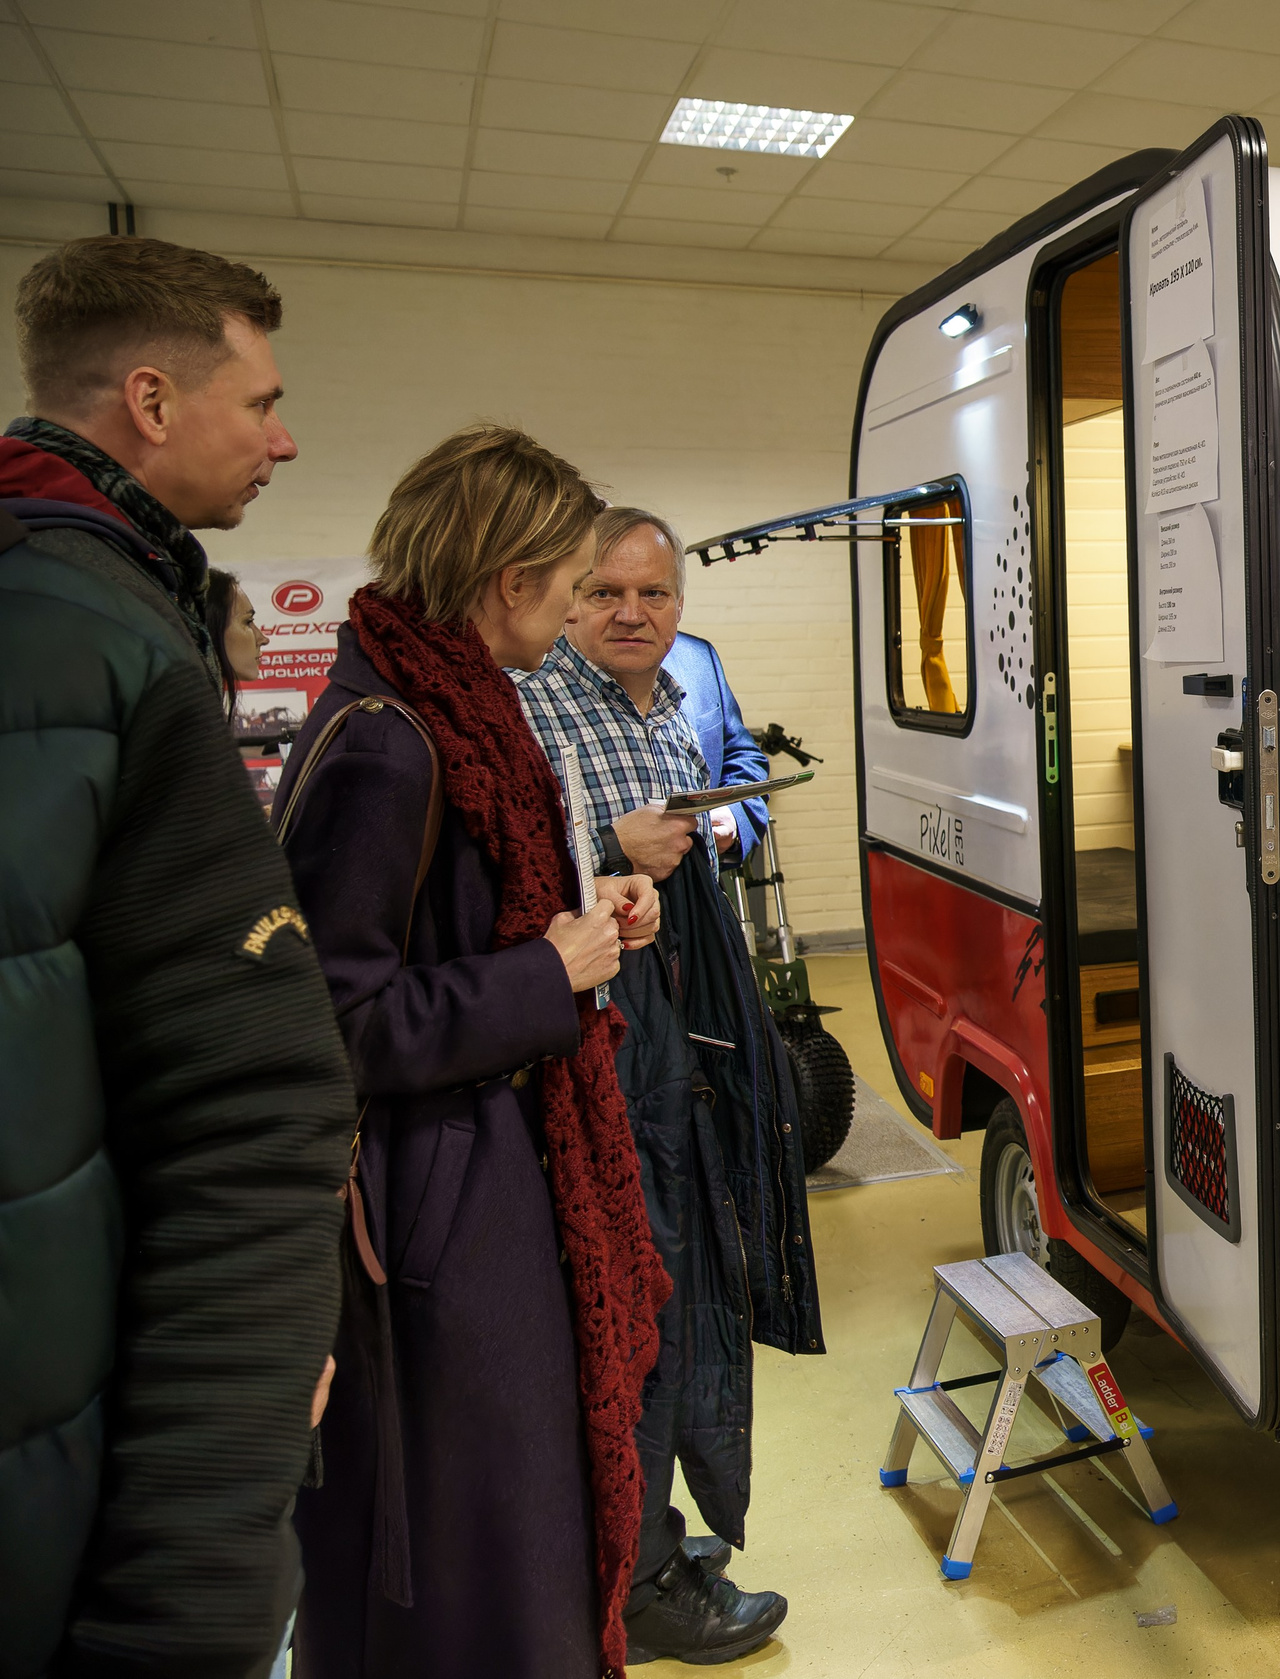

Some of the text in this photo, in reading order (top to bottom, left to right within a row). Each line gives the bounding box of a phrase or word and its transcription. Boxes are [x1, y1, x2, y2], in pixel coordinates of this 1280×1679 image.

[1149, 277, 1170, 297] Кровать
[1170, 268, 1180, 285] 195
[1185, 259, 1195, 277] 120
[260, 621, 342, 636] УСОХО
[260, 653, 338, 666] ЗДЕХОД
[920, 804, 950, 861] Pixel
[954, 818, 965, 866] 230
[1094, 1370, 1133, 1434] Ladder Bel
